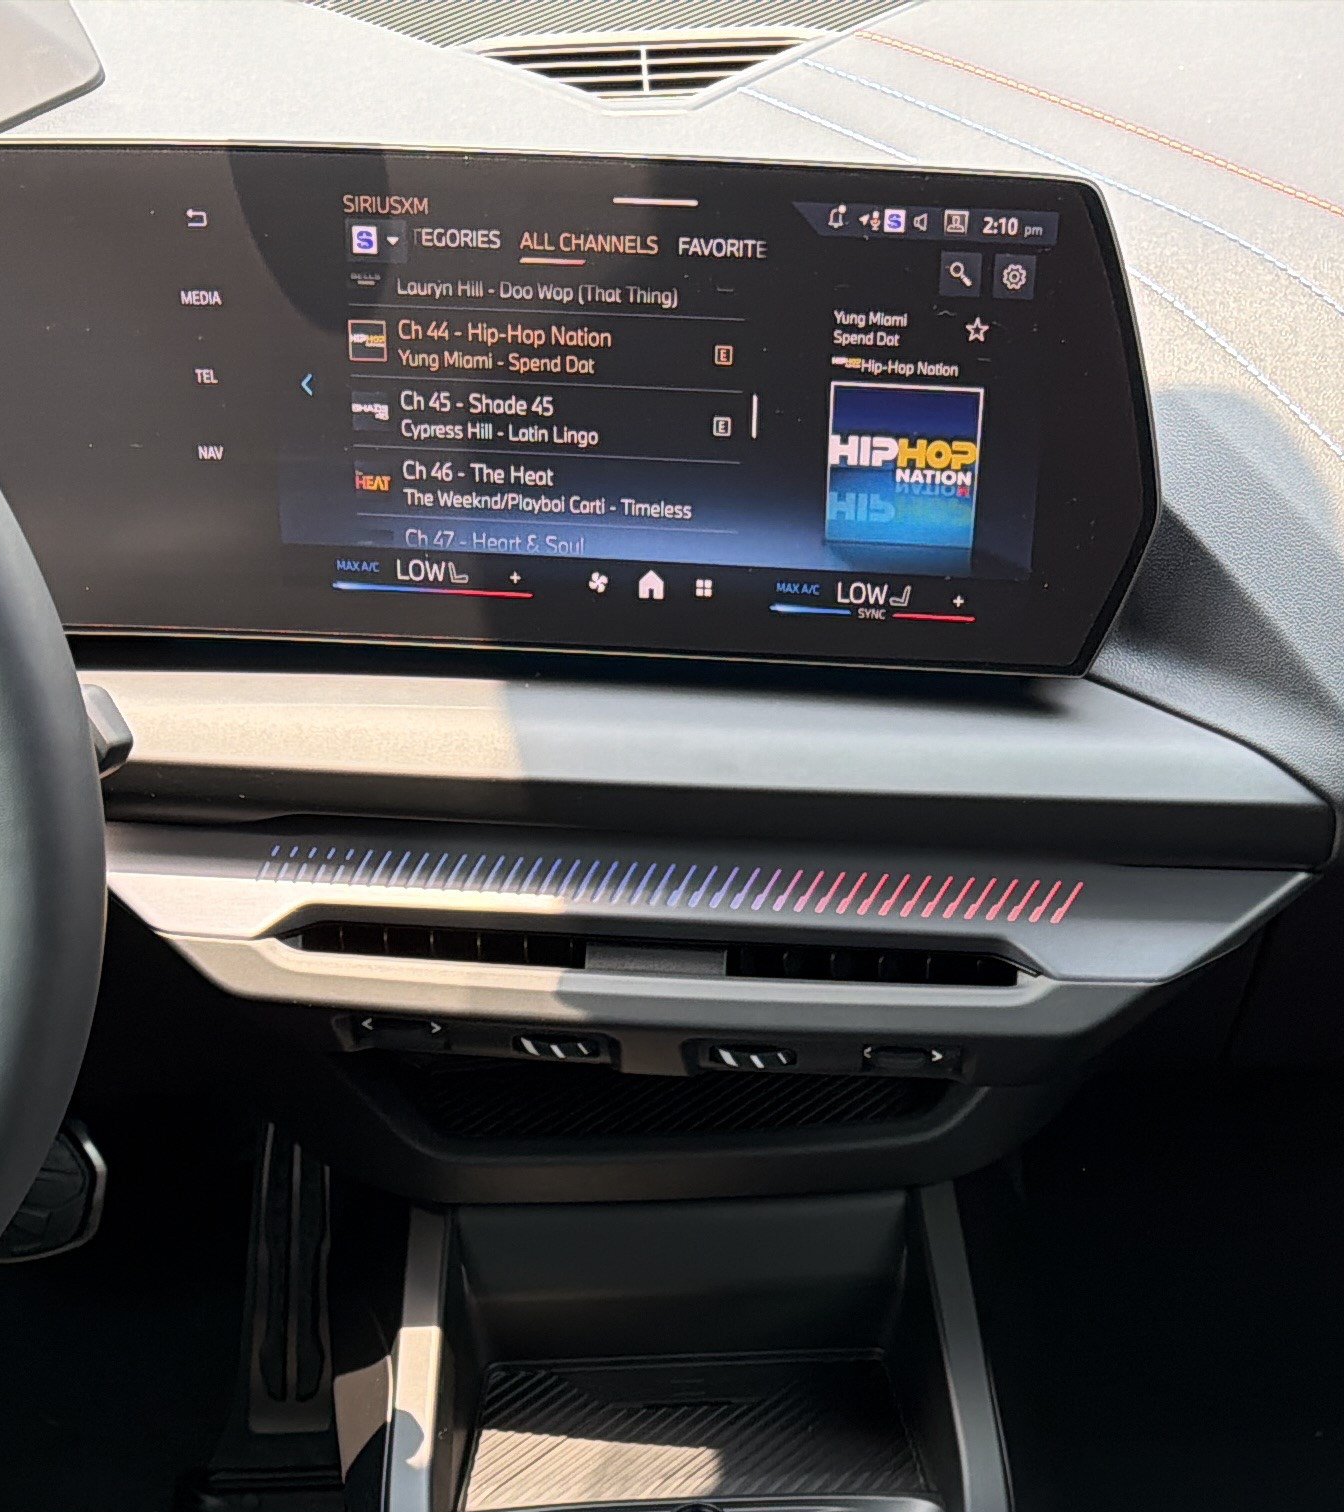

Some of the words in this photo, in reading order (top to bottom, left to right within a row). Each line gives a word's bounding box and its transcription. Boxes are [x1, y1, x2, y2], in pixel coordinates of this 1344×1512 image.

[343, 194, 429, 216] SIRIUSXM
[981, 216, 1019, 236] 2:10
[1024, 224, 1043, 238] pm
[519, 231, 555, 252] ALL
[559, 233, 659, 255] CHANNELS
[678, 236, 767, 259] FAVORITE
[180, 290, 222, 306] MEDIA
[397, 278, 453, 300] Lauryn
[457, 279, 484, 299] Hill
[499, 282, 534, 300] Doo
[537, 283, 574, 304] Wop
[578, 283, 623, 306] (That
[626, 287, 678, 309] Thing)
[833, 310, 866, 328] Yung
[869, 310, 908, 328] Miami
[398, 319, 423, 341] Ch
[426, 320, 450, 342] 44
[467, 322, 547, 348] Hip-Hop
[551, 326, 612, 348] Nation
[833, 329, 874, 347] Spend
[877, 331, 900, 347] Dat
[398, 349, 440, 372] Yung
[444, 351, 493, 371] Miami
[508, 353, 561, 375] Spend
[565, 356, 595, 375] Dat
[861, 357, 914, 377] Hip-Hop
[917, 360, 958, 377] Nation
[195, 368, 218, 384] TEL
[400, 390, 424, 412] Ch
[427, 391, 451, 412] 45
[469, 393, 527, 414] Shade
[531, 396, 554, 416] 45
[401, 420, 463, 444] Cypress
[467, 421, 493, 441] Hill
[508, 424, 549, 444] Latin
[552, 426, 599, 448] Lingo
[197, 445, 224, 461] NAV
[355, 474, 391, 492] HEAT
[403, 460, 426, 481] Ch
[429, 462, 453, 482] 46
[470, 463, 505, 485] The
[509, 466, 554, 486] Heat
[895, 468, 972, 486] NATION
[404, 489, 434, 508] The
[437, 491, 565, 514] Weeknd/Playboi
[569, 497, 605, 515] Carti
[620, 499, 693, 520] Timeless
[405, 529, 430, 548] Ch
[432, 530, 454, 549] 47
[472, 531, 522, 552] Heart
[545, 536, 585, 556] Soul
[336, 559, 360, 573] MAX
[361, 560, 380, 573] A/C
[395, 559, 446, 583] LOW
[776, 582, 800, 594] MAX
[801, 583, 820, 596] A/C
[836, 581, 889, 605] LOW
[857, 608, 887, 621] SYNC
